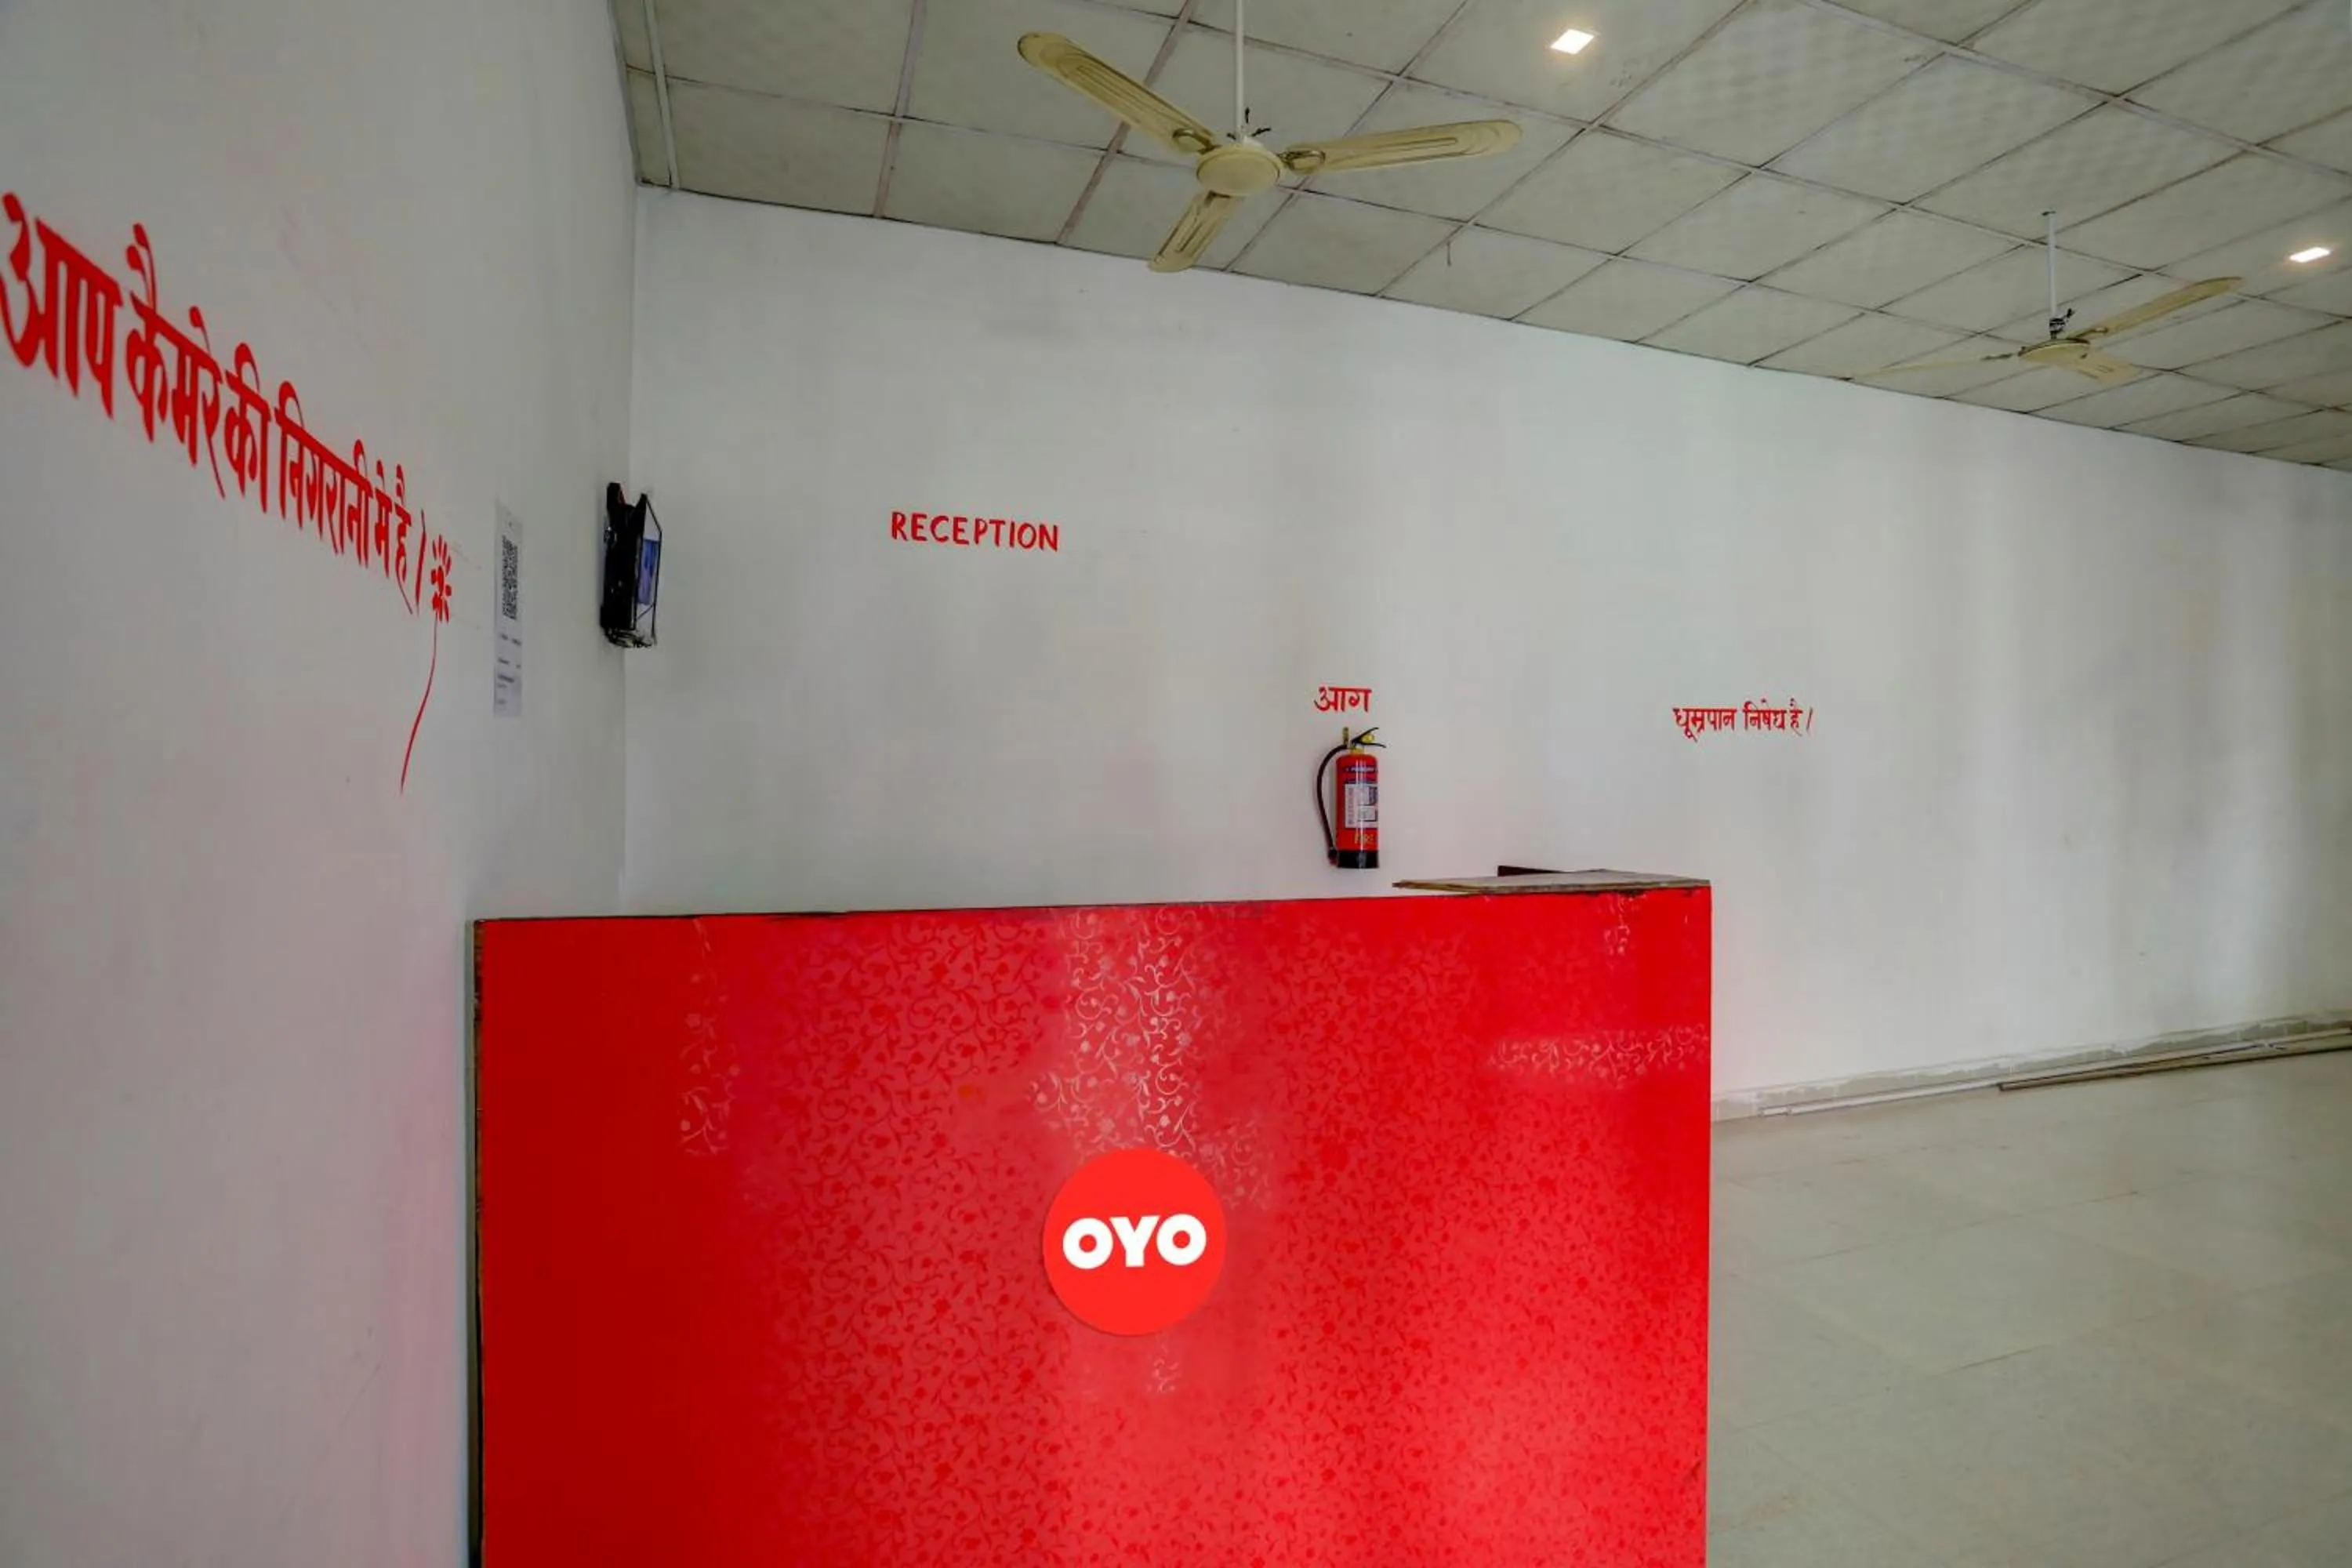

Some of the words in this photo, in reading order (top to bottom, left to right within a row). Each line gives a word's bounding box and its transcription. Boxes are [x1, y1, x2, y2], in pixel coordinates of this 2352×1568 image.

[0, 192, 123, 420] आप
[125, 223, 226, 500] कैमरे
[224, 343, 271, 514] की
[274, 381, 374, 568] निगरानी
[891, 511, 1059, 552] RECEPTION
[1314, 685, 1373, 713] आग
[1062, 1213, 1207, 1270] OYO
